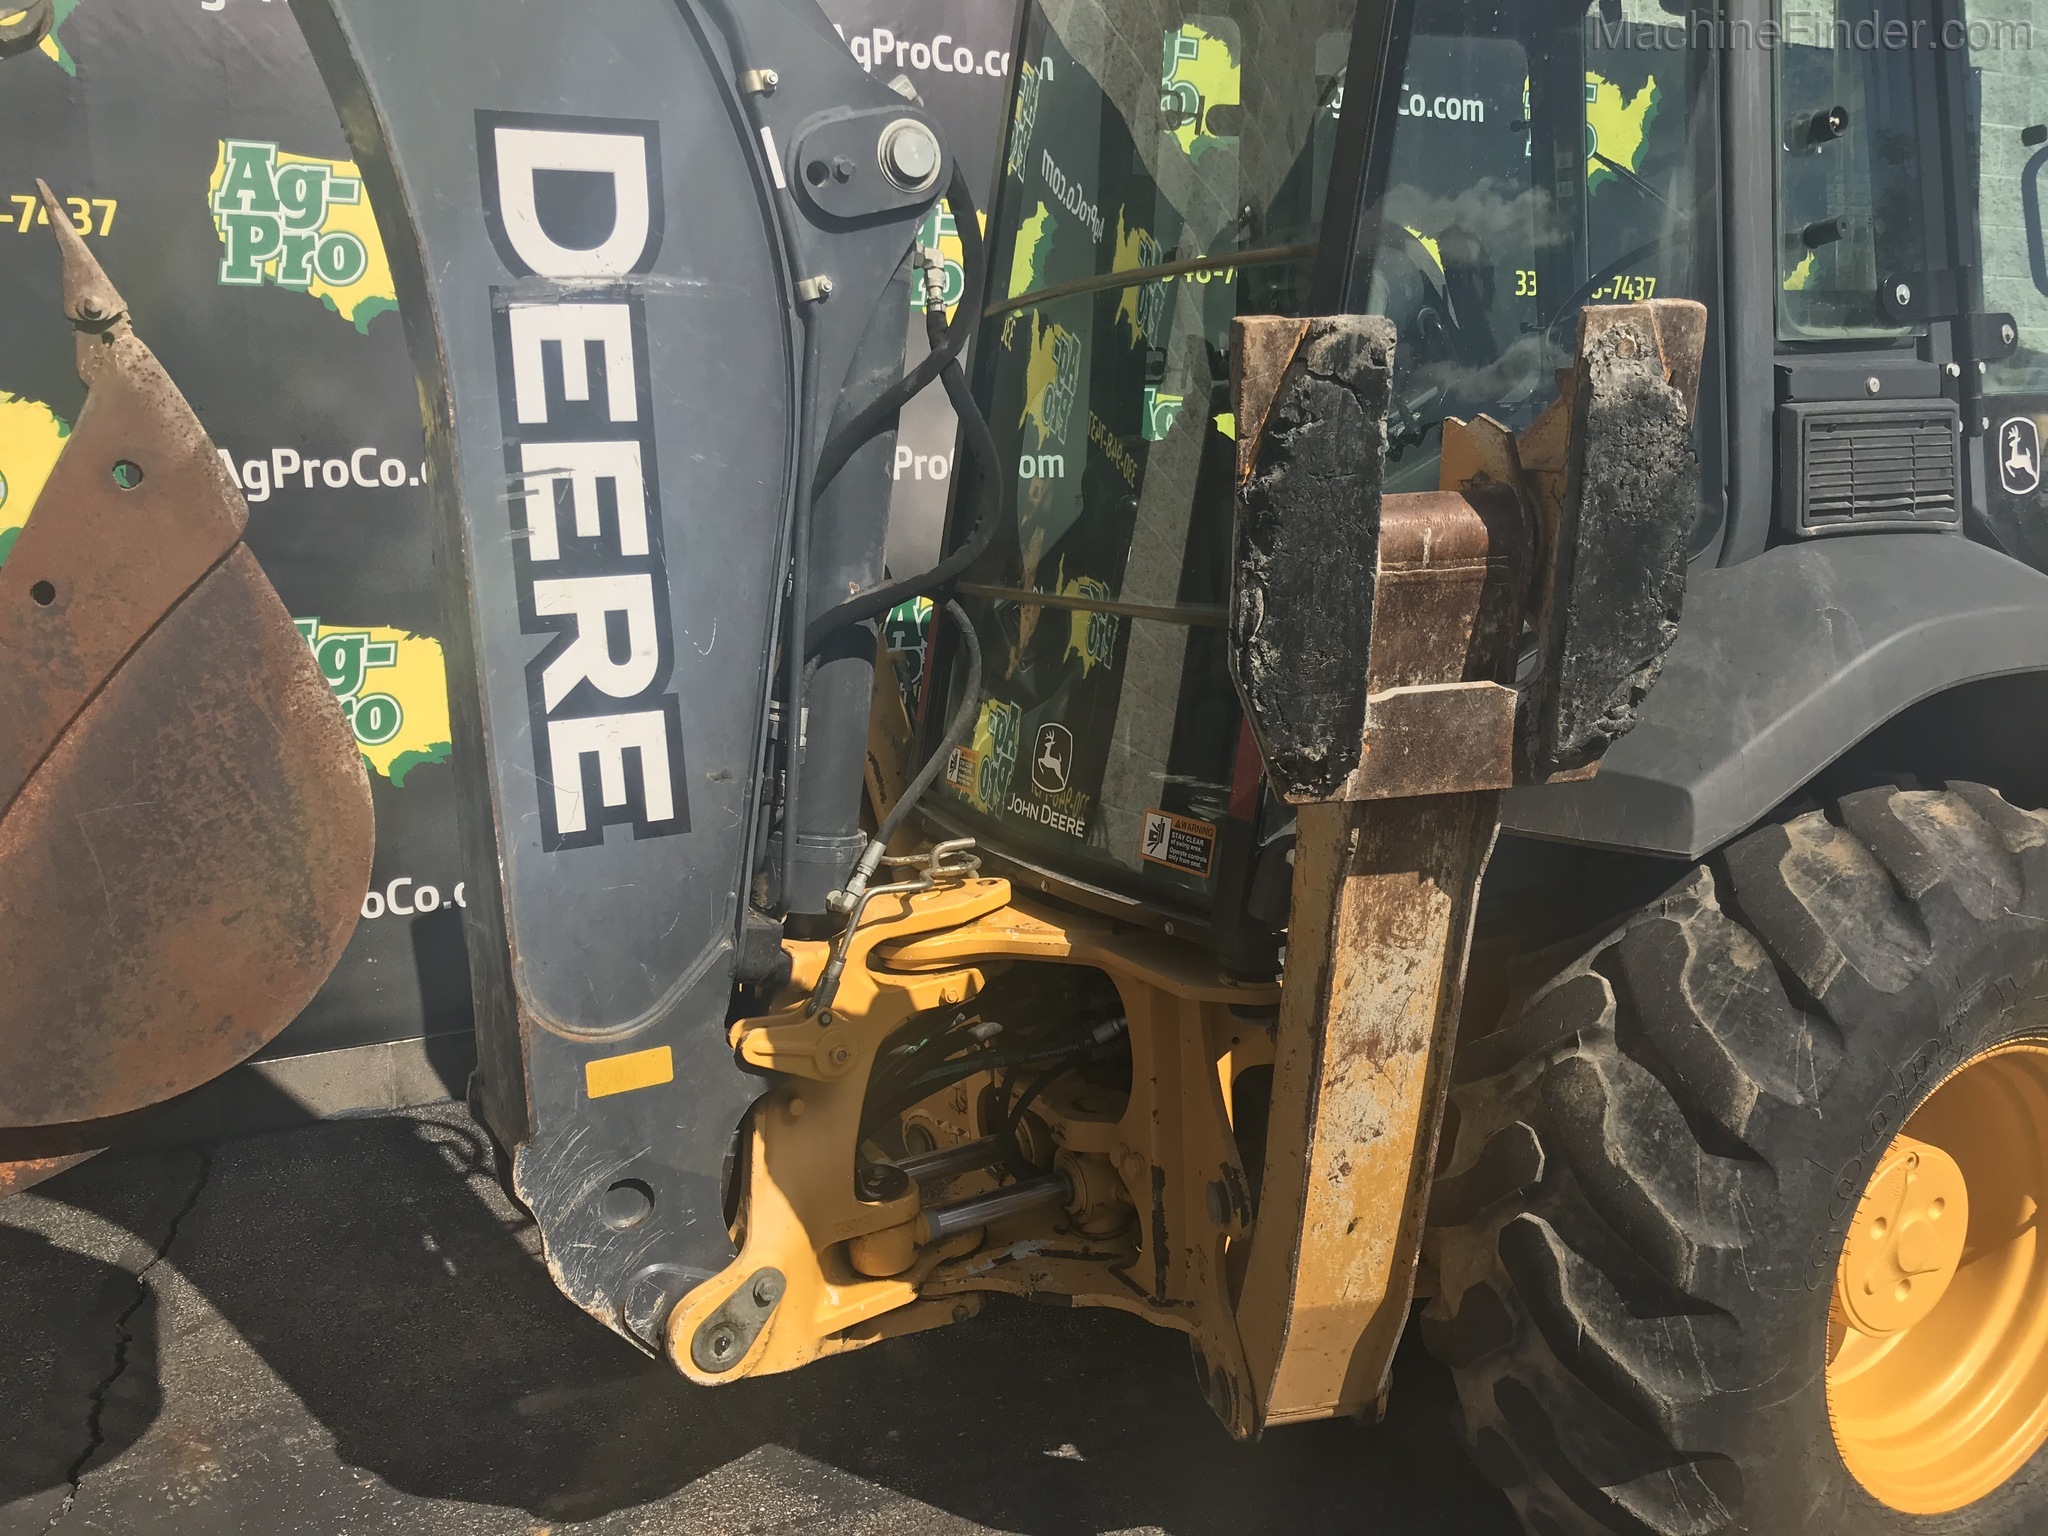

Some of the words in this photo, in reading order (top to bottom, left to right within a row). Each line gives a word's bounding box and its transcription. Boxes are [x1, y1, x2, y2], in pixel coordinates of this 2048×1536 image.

[215, 141, 361, 231] Ag-
[220, 212, 366, 285] Pro
[493, 127, 675, 834] DEERE
[1007, 793, 1039, 821] JOHN
[1040, 804, 1086, 839] DEERE
[1171, 831, 1186, 841] STAY
[1185, 835, 1205, 847] CLEAR
[1181, 820, 1214, 837] WARNING
[1169, 846, 1188, 858] Operate
